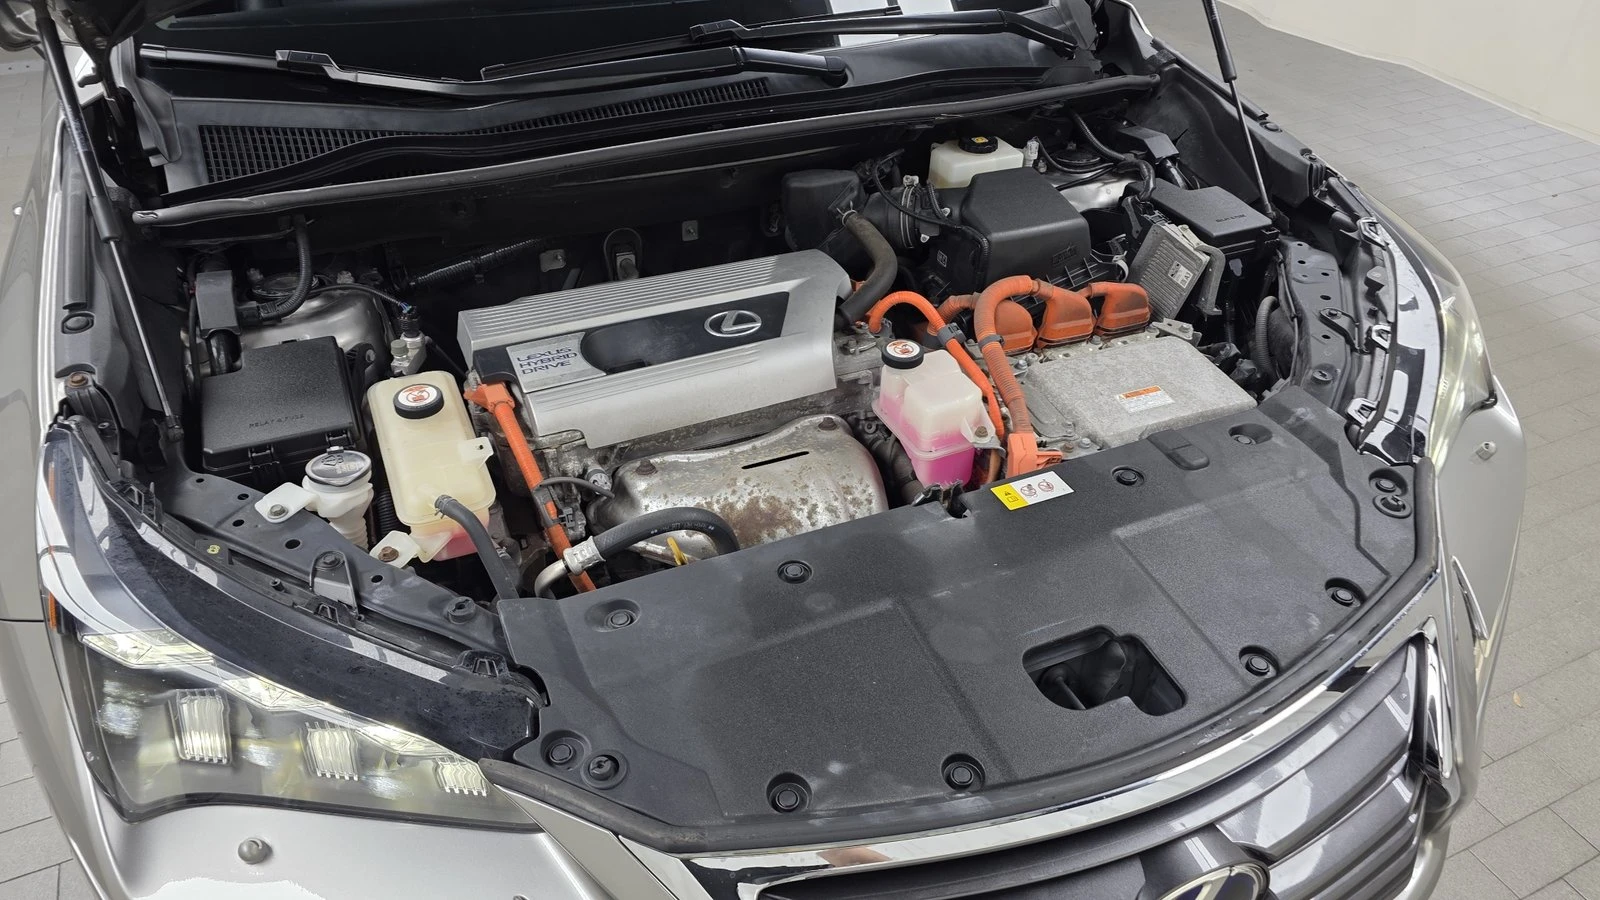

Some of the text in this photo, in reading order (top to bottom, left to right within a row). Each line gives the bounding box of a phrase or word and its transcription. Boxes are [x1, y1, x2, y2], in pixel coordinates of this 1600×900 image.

[517, 346, 572, 362] LEXUS
[519, 352, 578, 368] HYBRID
[521, 361, 571, 374] DRIVE
